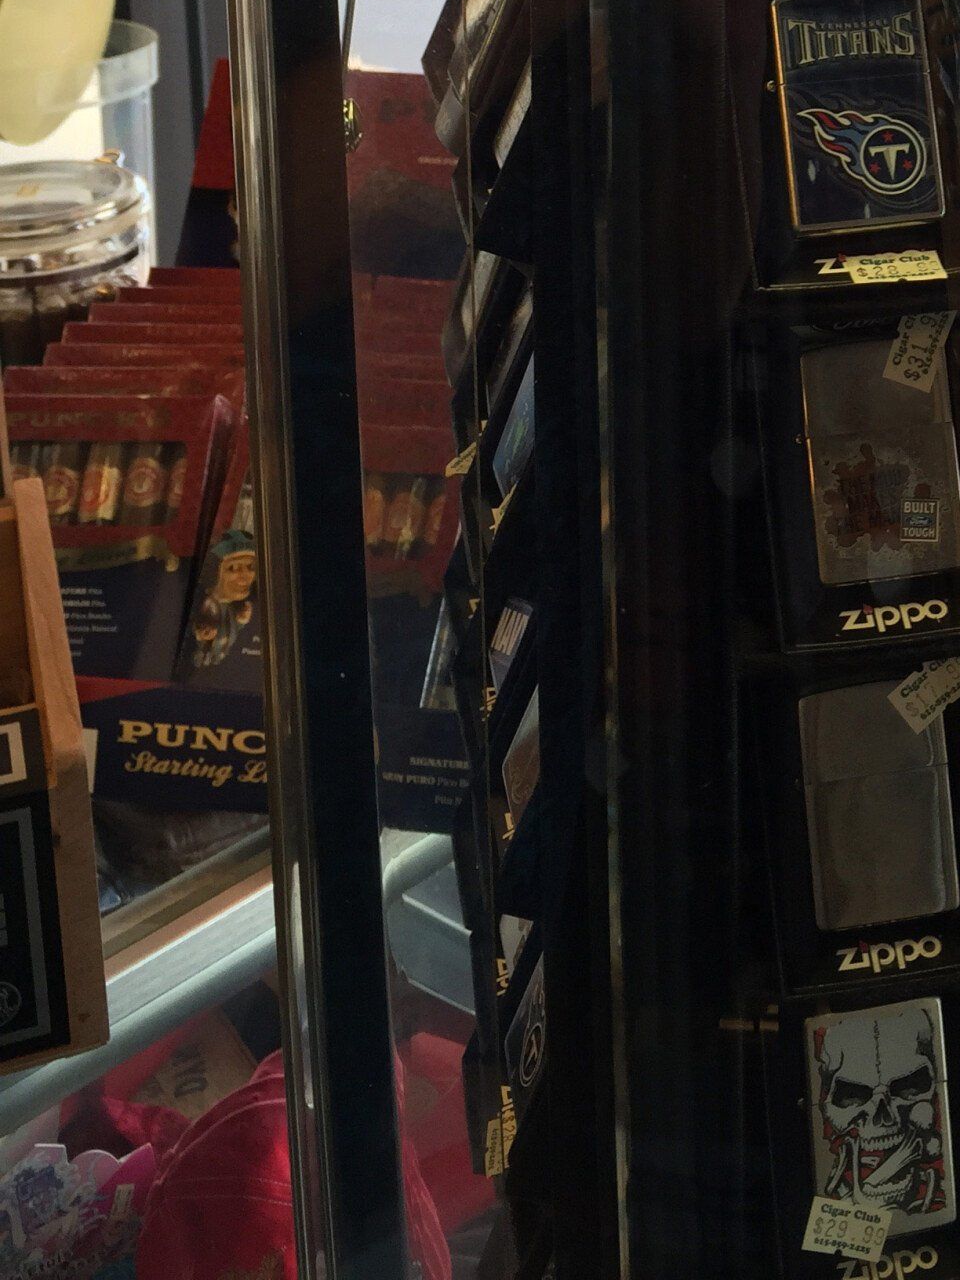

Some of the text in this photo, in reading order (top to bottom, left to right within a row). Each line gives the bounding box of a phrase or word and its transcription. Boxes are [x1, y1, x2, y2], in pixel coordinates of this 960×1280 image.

[860, 254, 930, 266] Cigar Club
[903, 501, 935, 513] BUILT
[902, 527, 935, 538] TOUGH
[124, 750, 233, 787] Starting
[820, 1203, 881, 1224] Cigar Club
